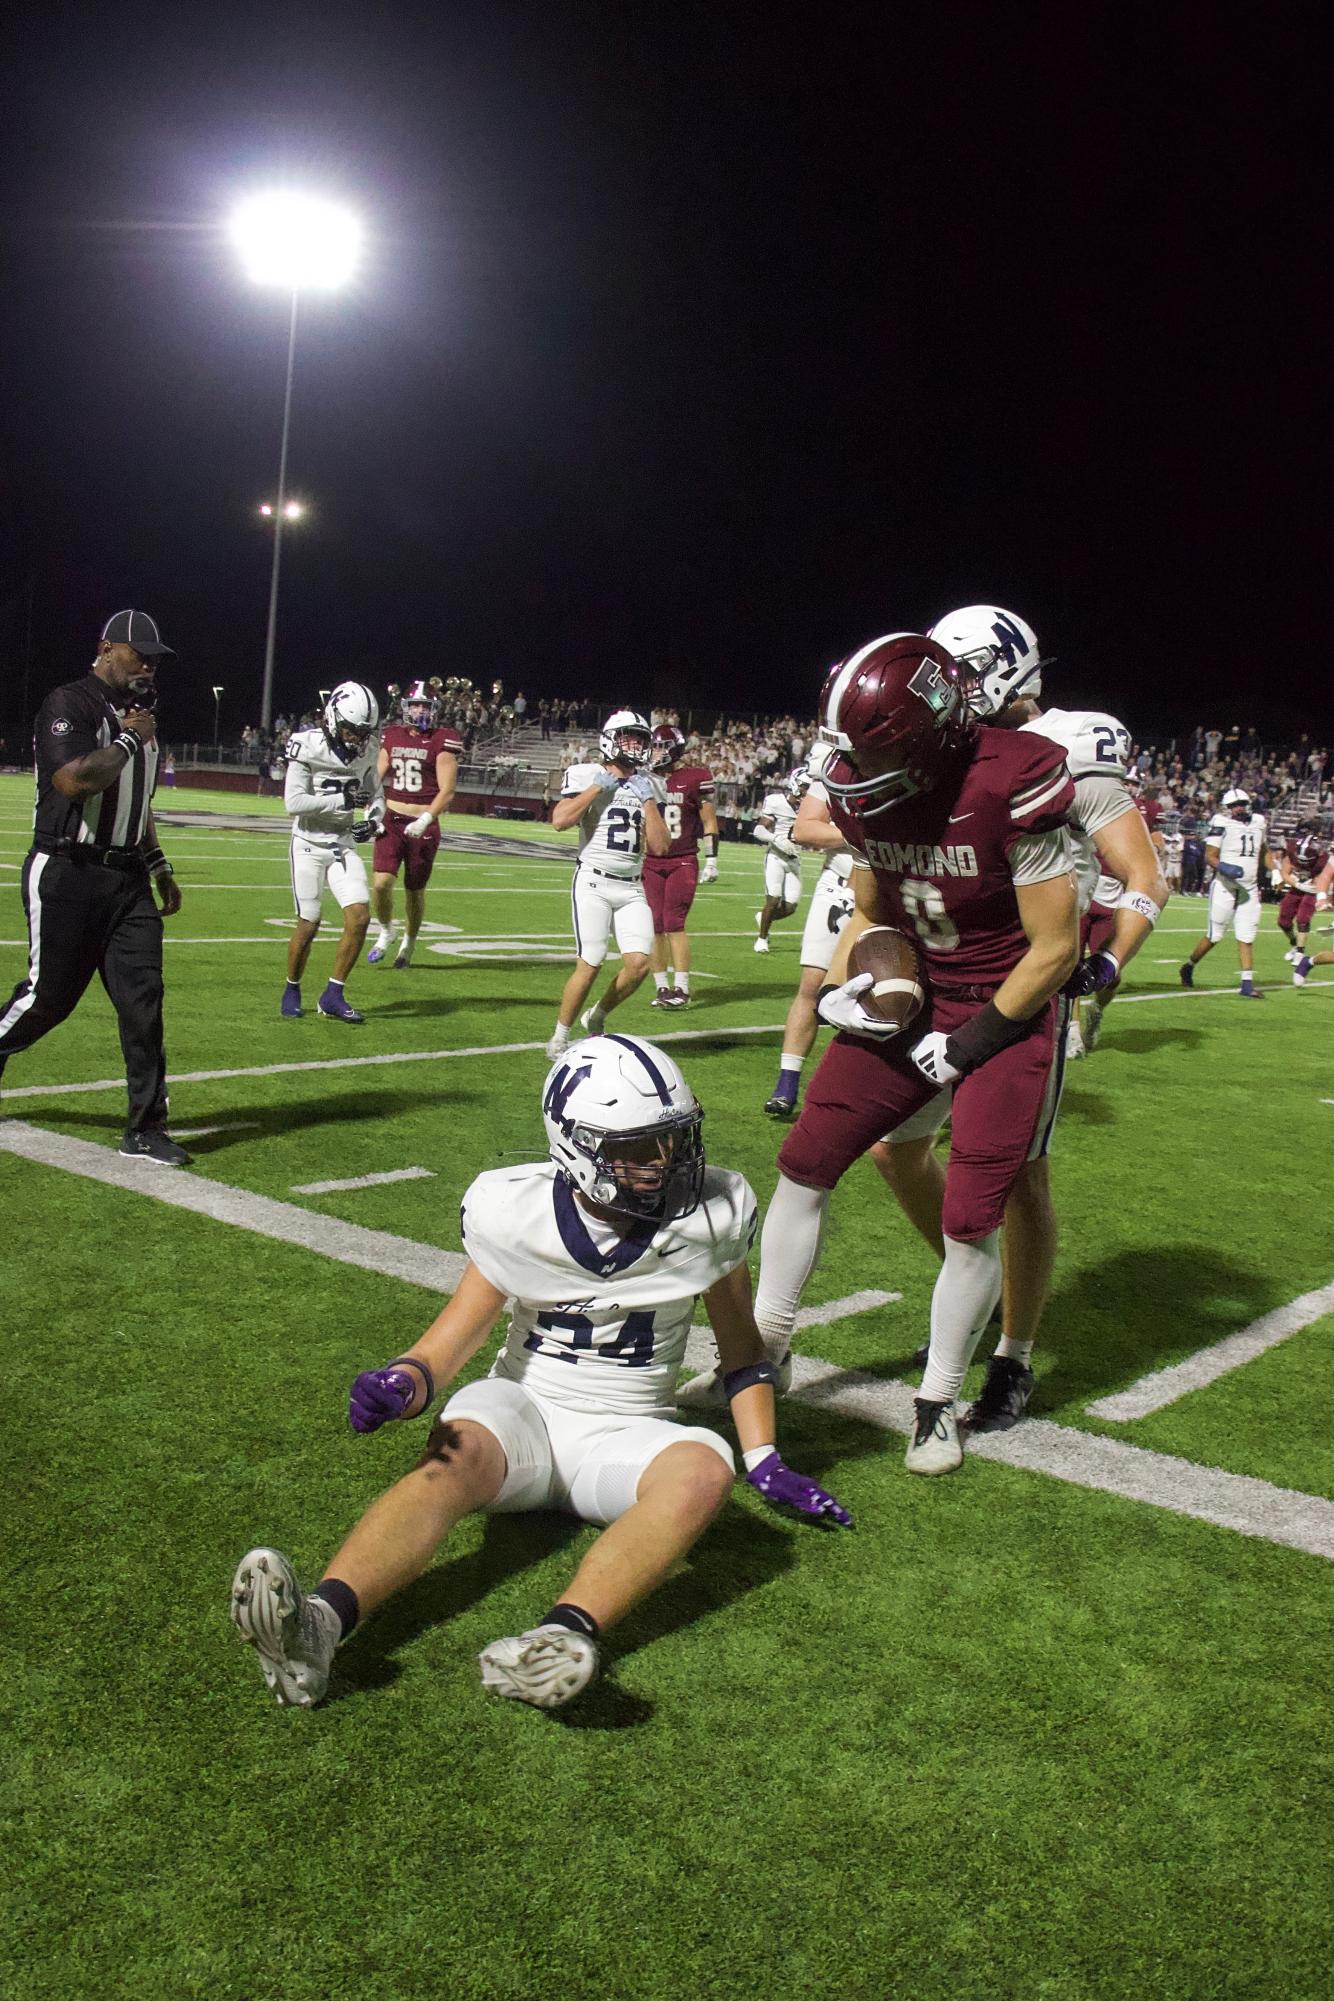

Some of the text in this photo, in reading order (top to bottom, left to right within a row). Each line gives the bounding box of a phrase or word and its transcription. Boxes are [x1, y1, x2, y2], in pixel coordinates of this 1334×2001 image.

[391, 760, 422, 792] 36
[606, 807, 641, 853] 21
[1239, 834, 1255, 857] 11
[864, 838, 979, 877] EDMOND
[523, 1310, 657, 1367] 24
